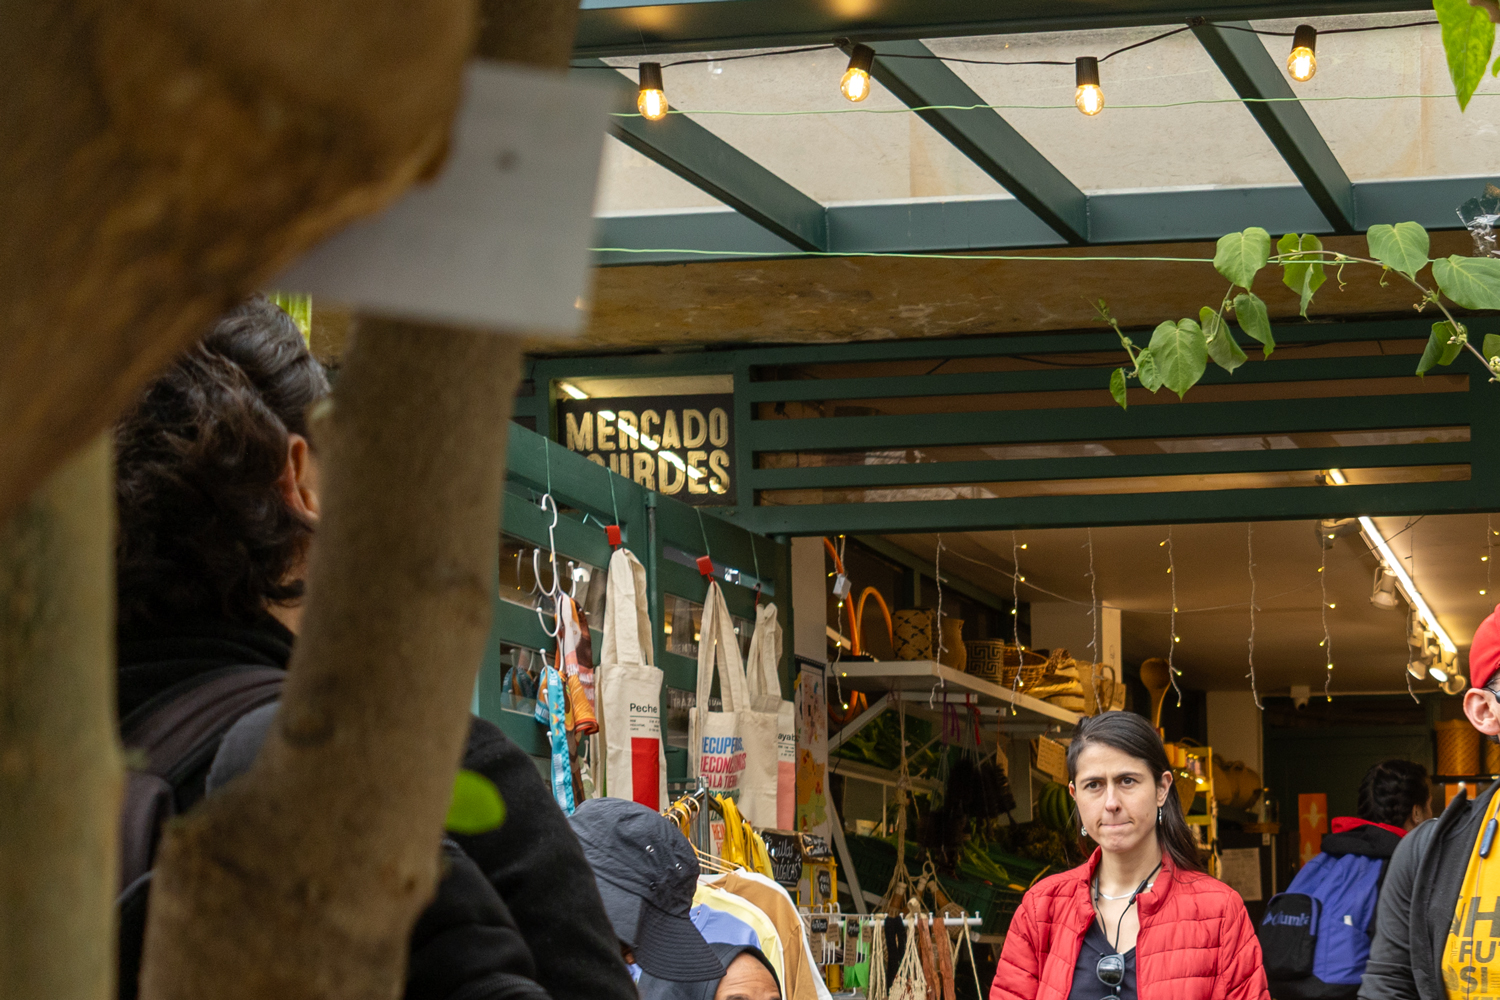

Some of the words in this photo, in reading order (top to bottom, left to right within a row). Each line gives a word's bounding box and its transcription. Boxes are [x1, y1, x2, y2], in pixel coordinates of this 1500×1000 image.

[566, 407, 729, 451] MERCADO
[629, 703, 658, 713] Peche
[1459, 966, 1488, 993] SI
